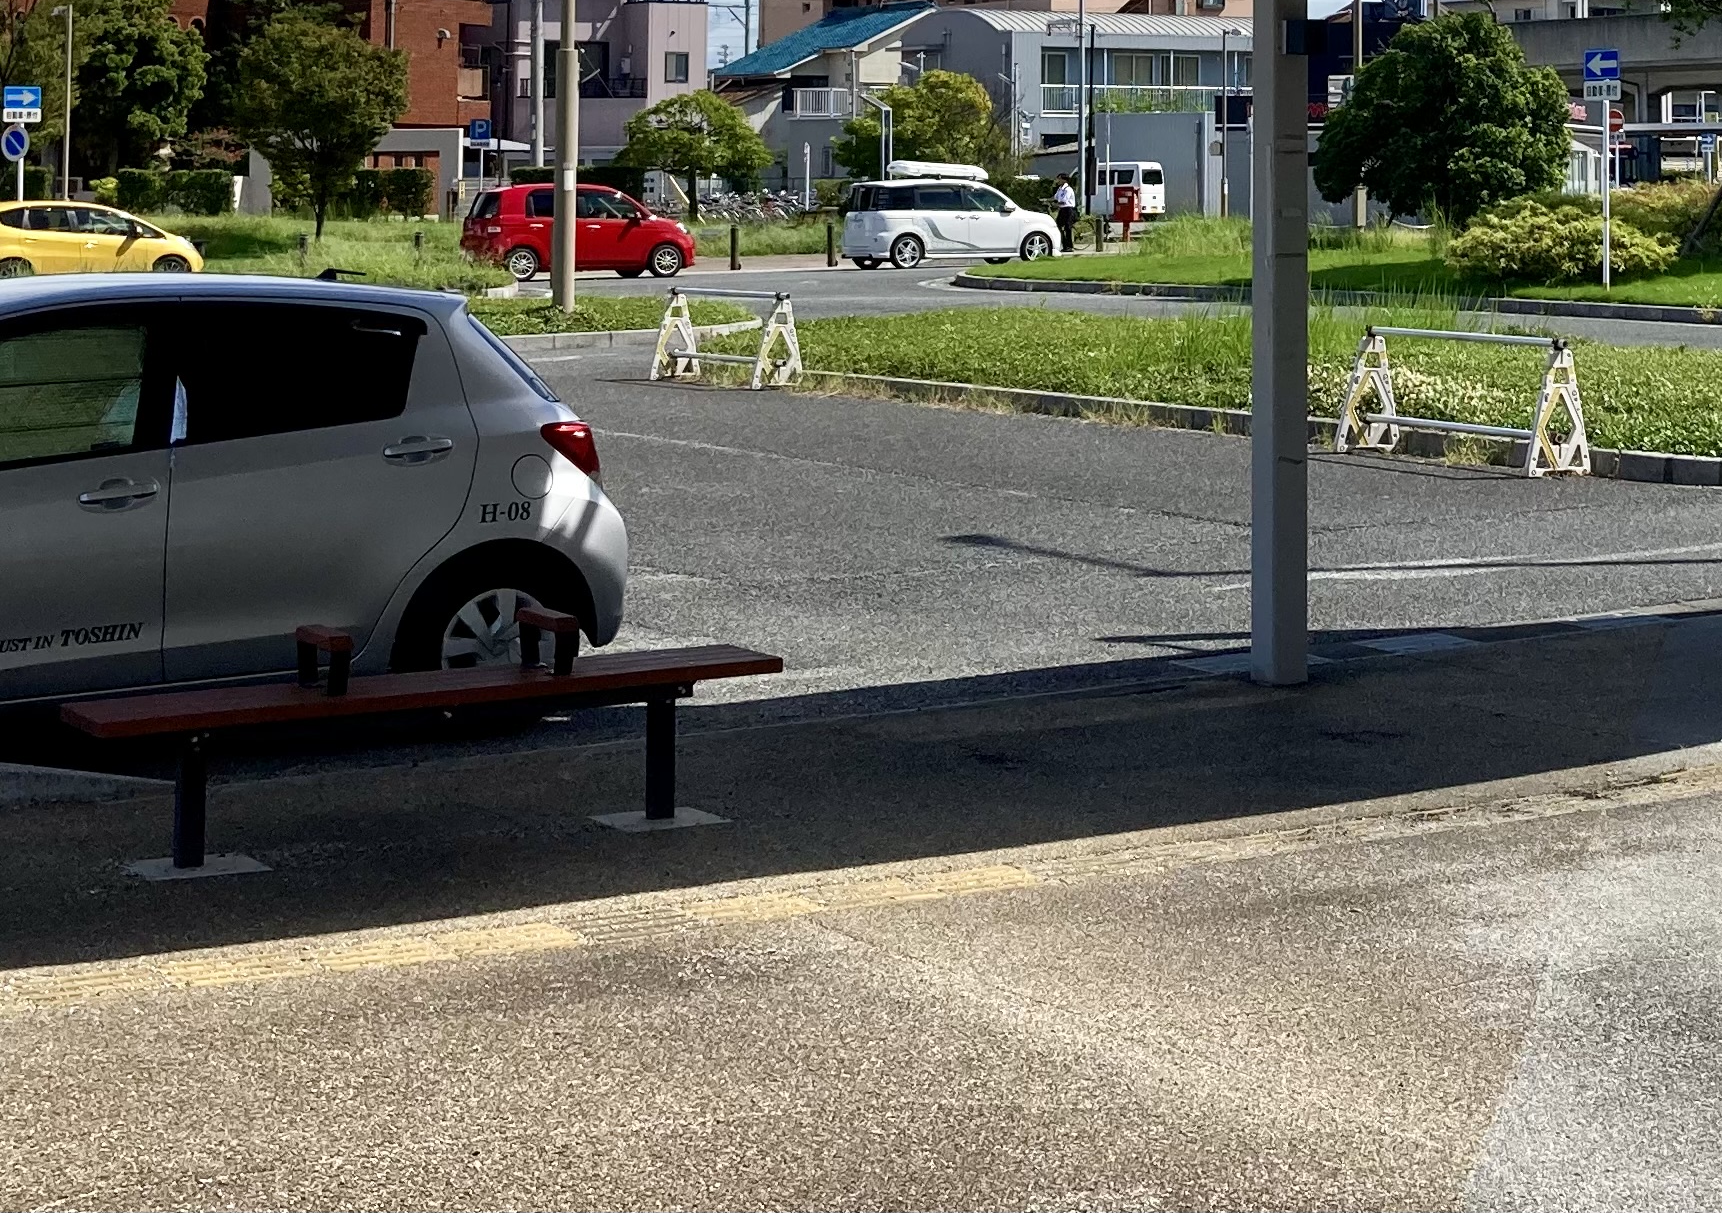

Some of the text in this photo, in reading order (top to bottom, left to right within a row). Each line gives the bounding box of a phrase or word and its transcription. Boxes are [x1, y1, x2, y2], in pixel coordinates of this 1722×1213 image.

[479, 500, 531, 524] H-08
[33, 634, 55, 650] IN
[60, 622, 143, 646] TOSHIN
